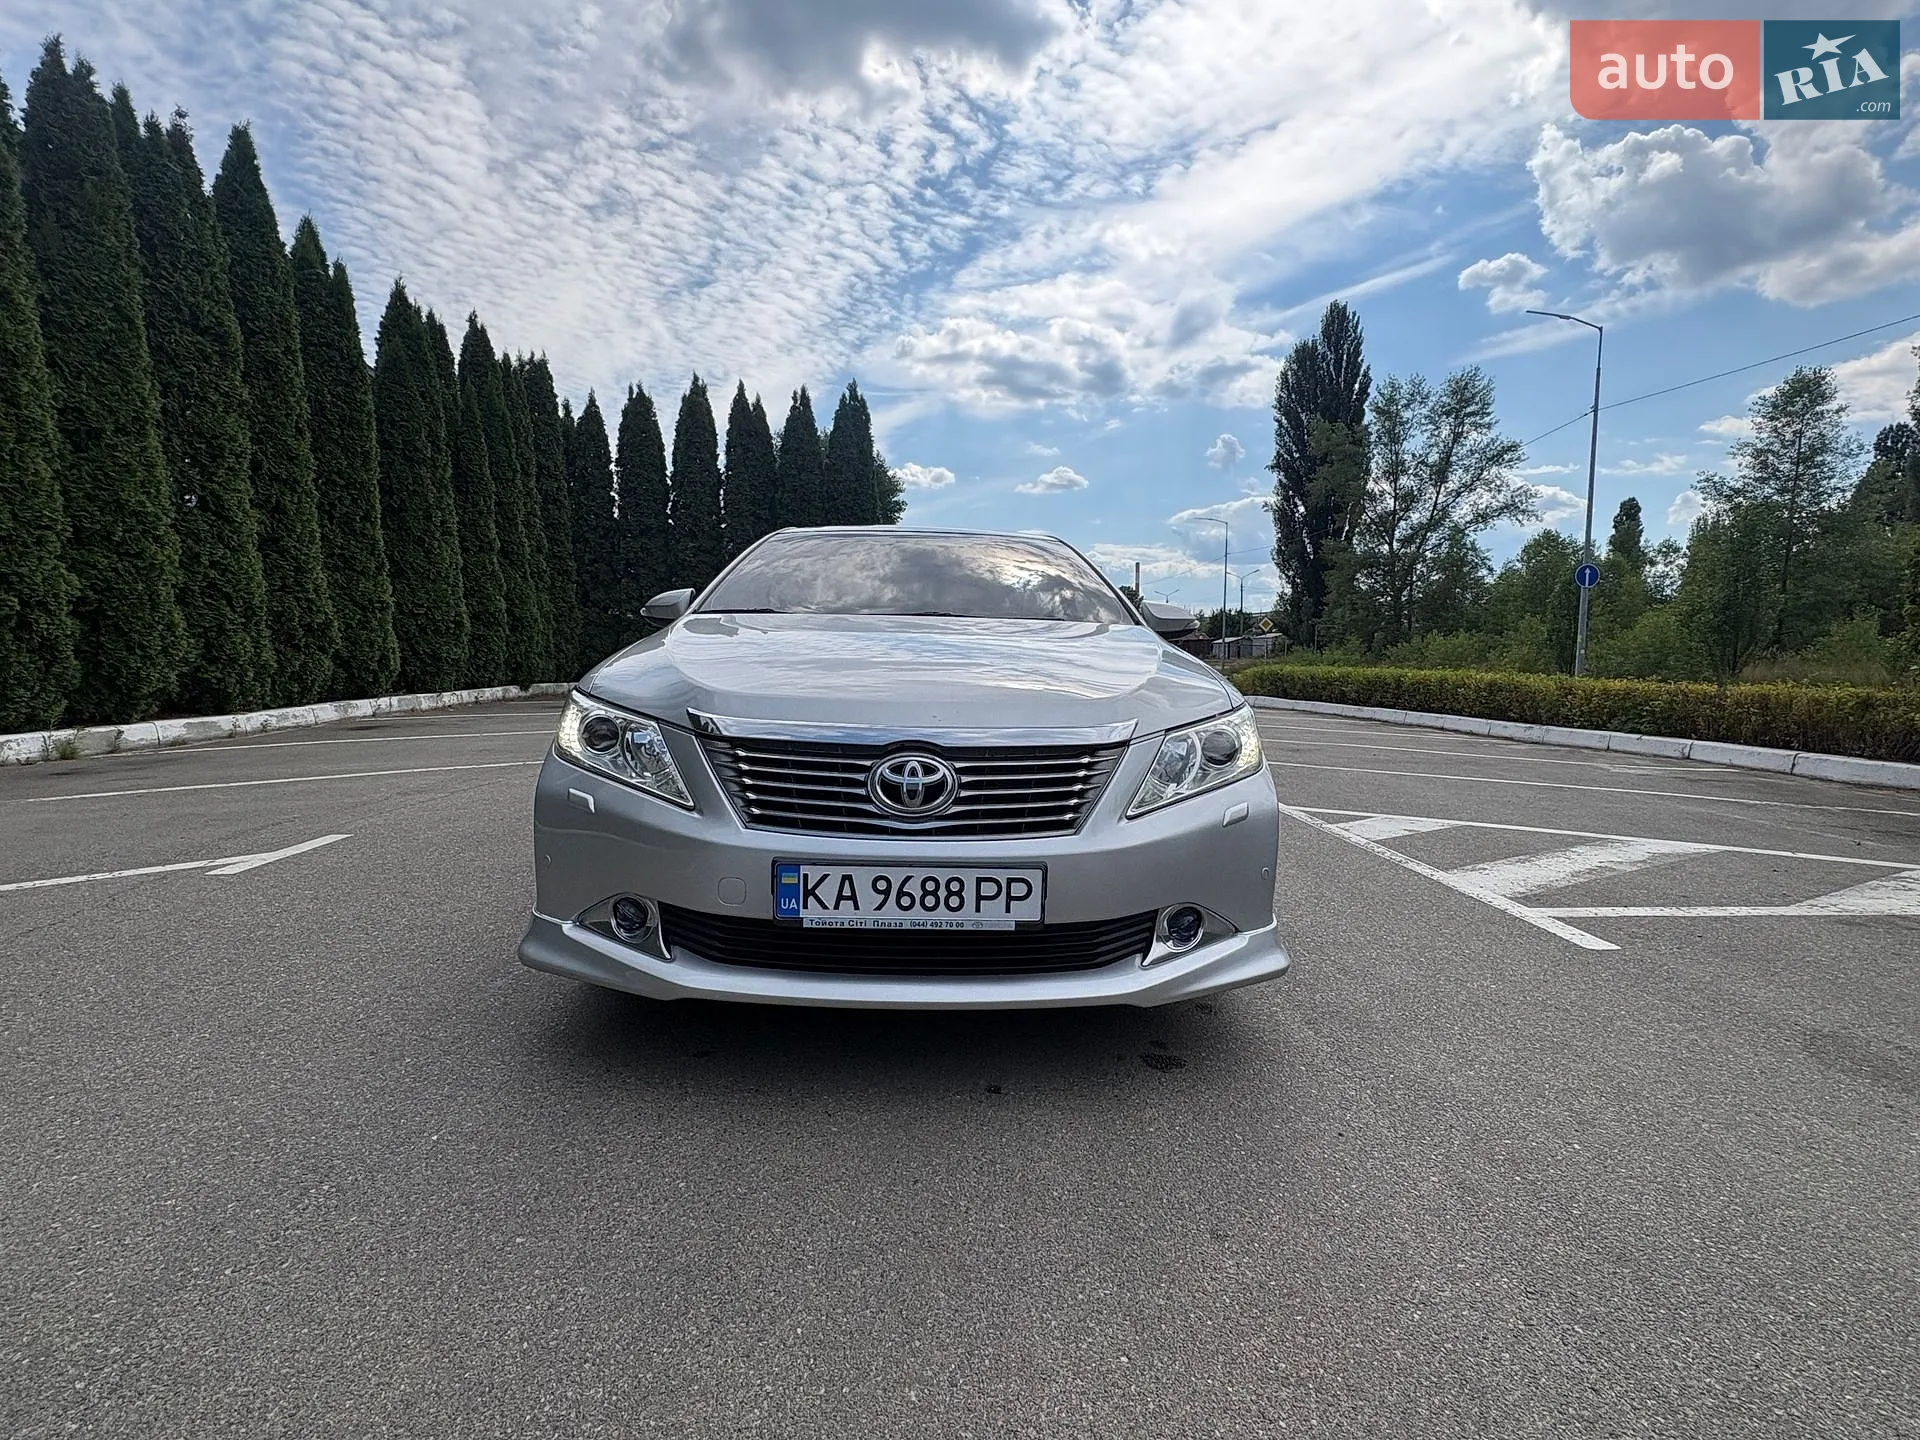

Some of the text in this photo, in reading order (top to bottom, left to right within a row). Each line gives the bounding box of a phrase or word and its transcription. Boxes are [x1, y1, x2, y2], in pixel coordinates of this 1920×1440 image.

[802, 873, 1033, 914] KA 9688 PP
[781, 897, 798, 909] UA
[873, 920, 904, 928] Плаза
